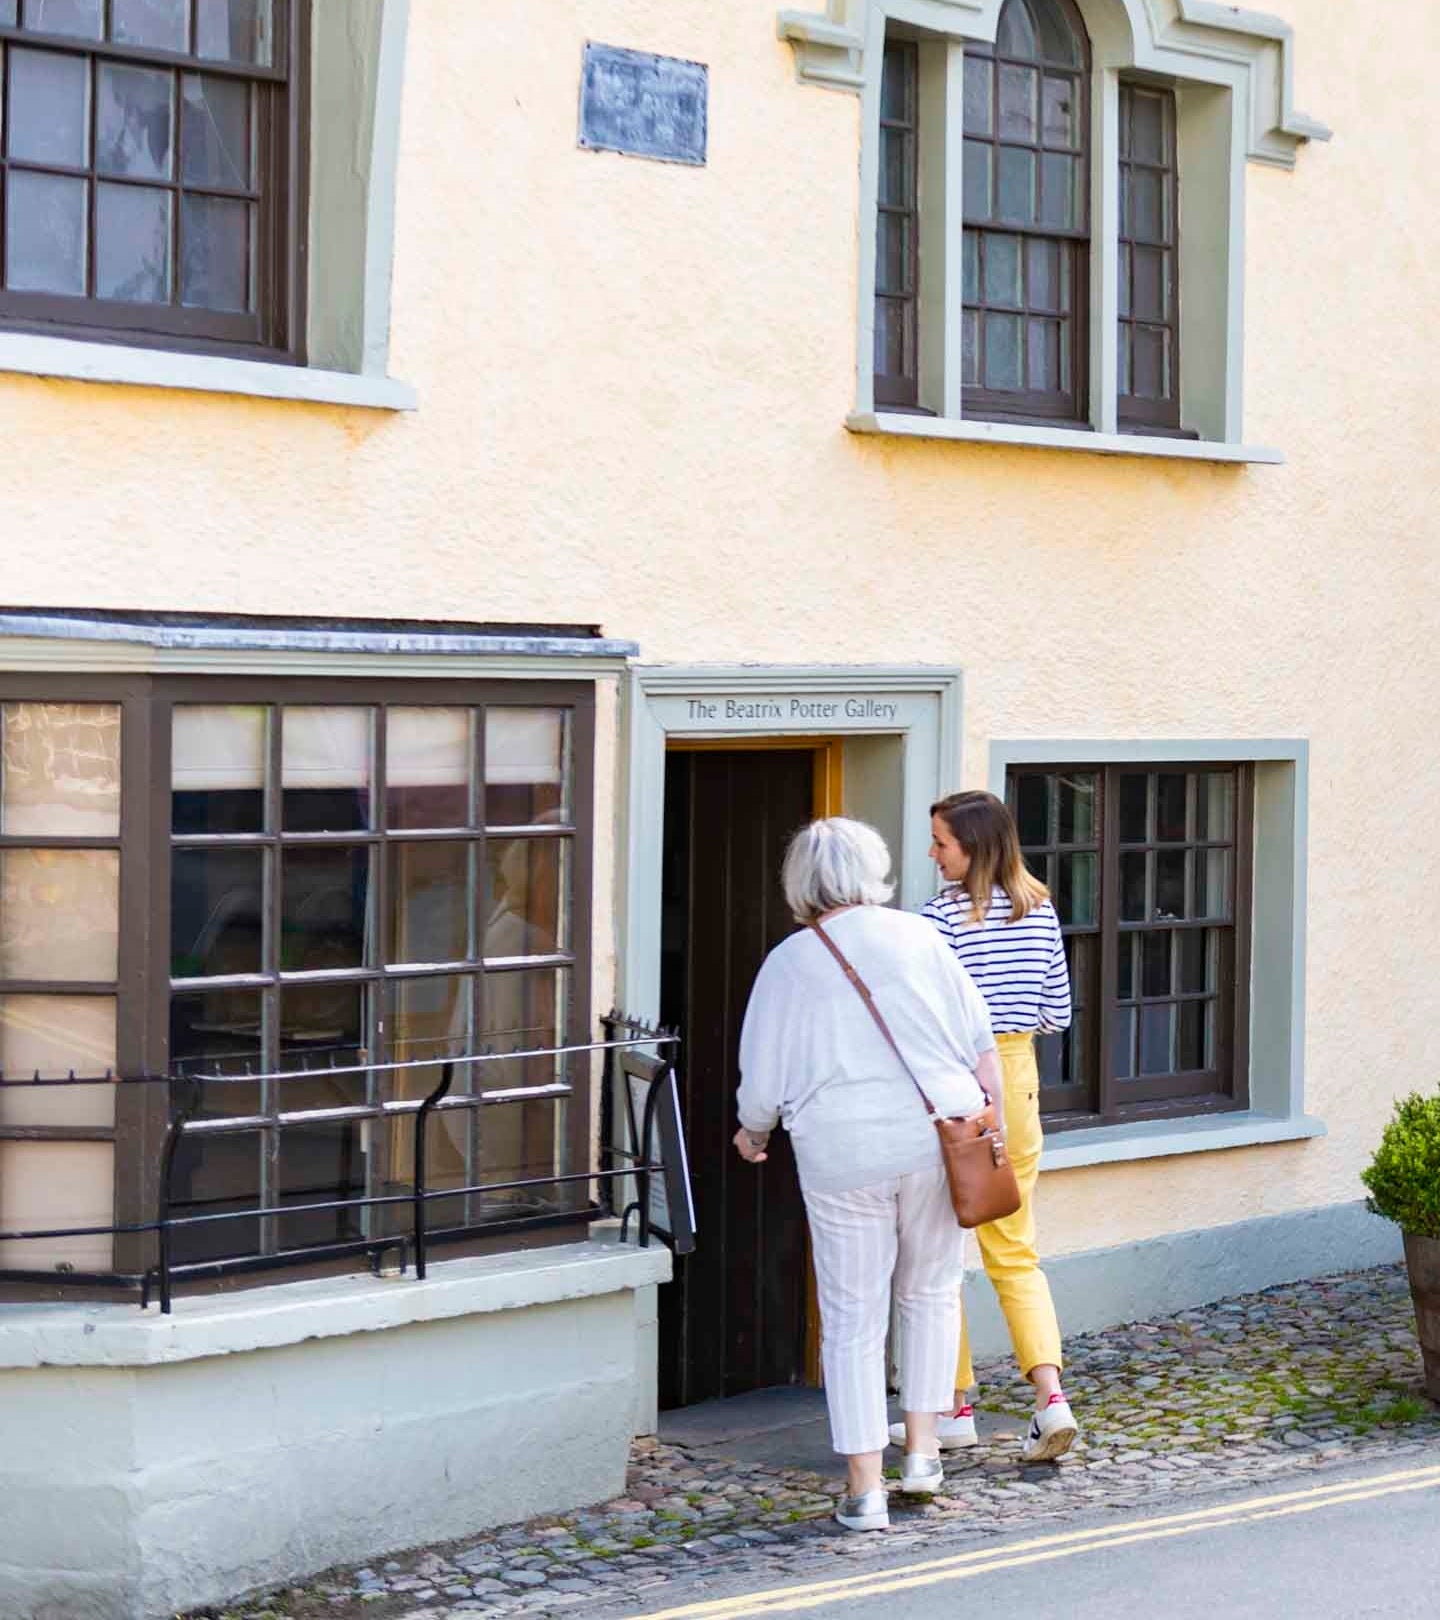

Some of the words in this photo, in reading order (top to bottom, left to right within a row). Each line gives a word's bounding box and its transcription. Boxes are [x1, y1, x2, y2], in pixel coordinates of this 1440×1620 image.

[686, 699, 718, 720] The
[724, 699, 783, 719] Beatrix
[789, 698, 839, 718] Potter
[843, 698, 898, 722] Gallery
